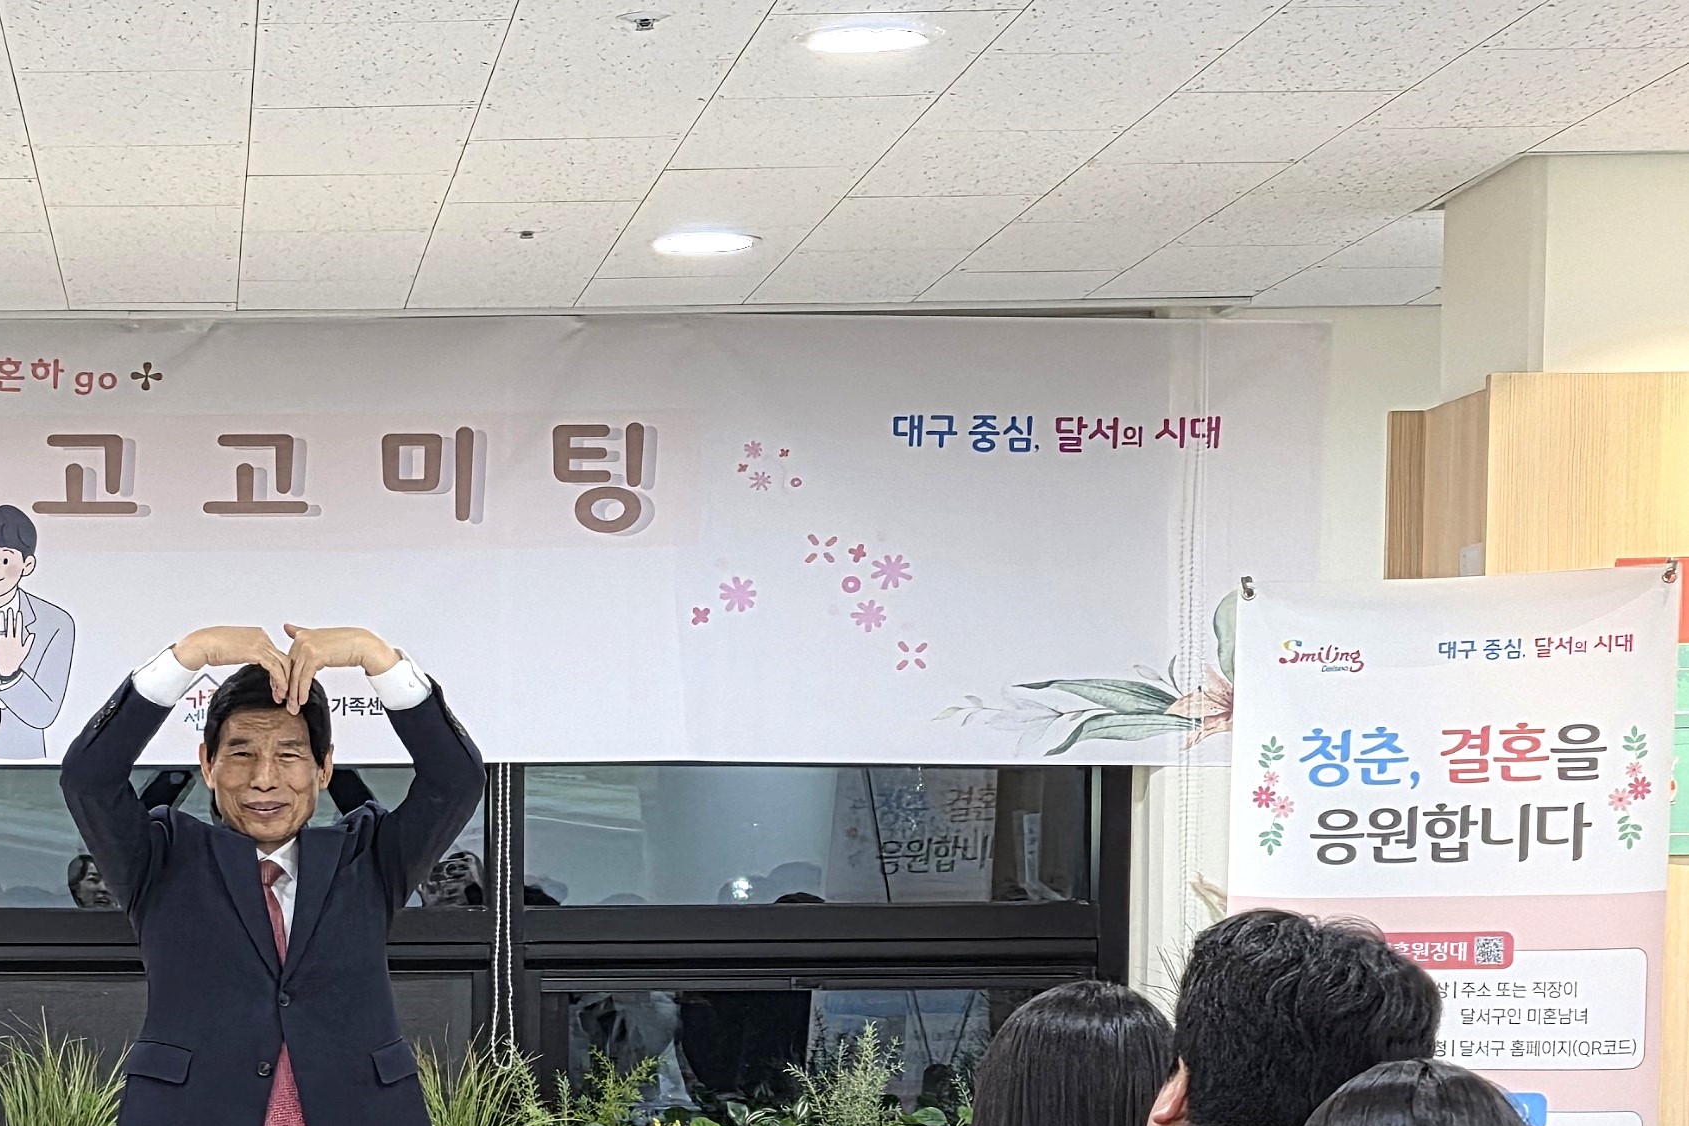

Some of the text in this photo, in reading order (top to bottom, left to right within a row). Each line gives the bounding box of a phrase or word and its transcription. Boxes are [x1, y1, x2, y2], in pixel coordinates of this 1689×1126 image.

[74, 370, 118, 396] go
[892, 414, 1222, 453] 대구 중심, 달서의 시대
[31, 421, 652, 536] 고고미팅
[1279, 639, 1364, 672] Smiling
[1438, 640, 1477, 660] 대구
[1535, 636, 1587, 658] 달서의
[1593, 633, 1634, 653] 시대
[1299, 722, 1608, 790] 청춘, 결혼을
[1309, 802, 1593, 866] 응원합니다
[1388, 941, 1468, 962] 혼원정대
[1461, 981, 1492, 999] 주소
[1495, 981, 1527, 999] 또는
[1532, 981, 1578, 999] 직장이
[1461, 1007, 1589, 1026] 달서구인 미혼남녀
[1459, 1039, 1506, 1057] 달서구
[1510, 1038, 1638, 1057] 홈페이지(QR코드)
